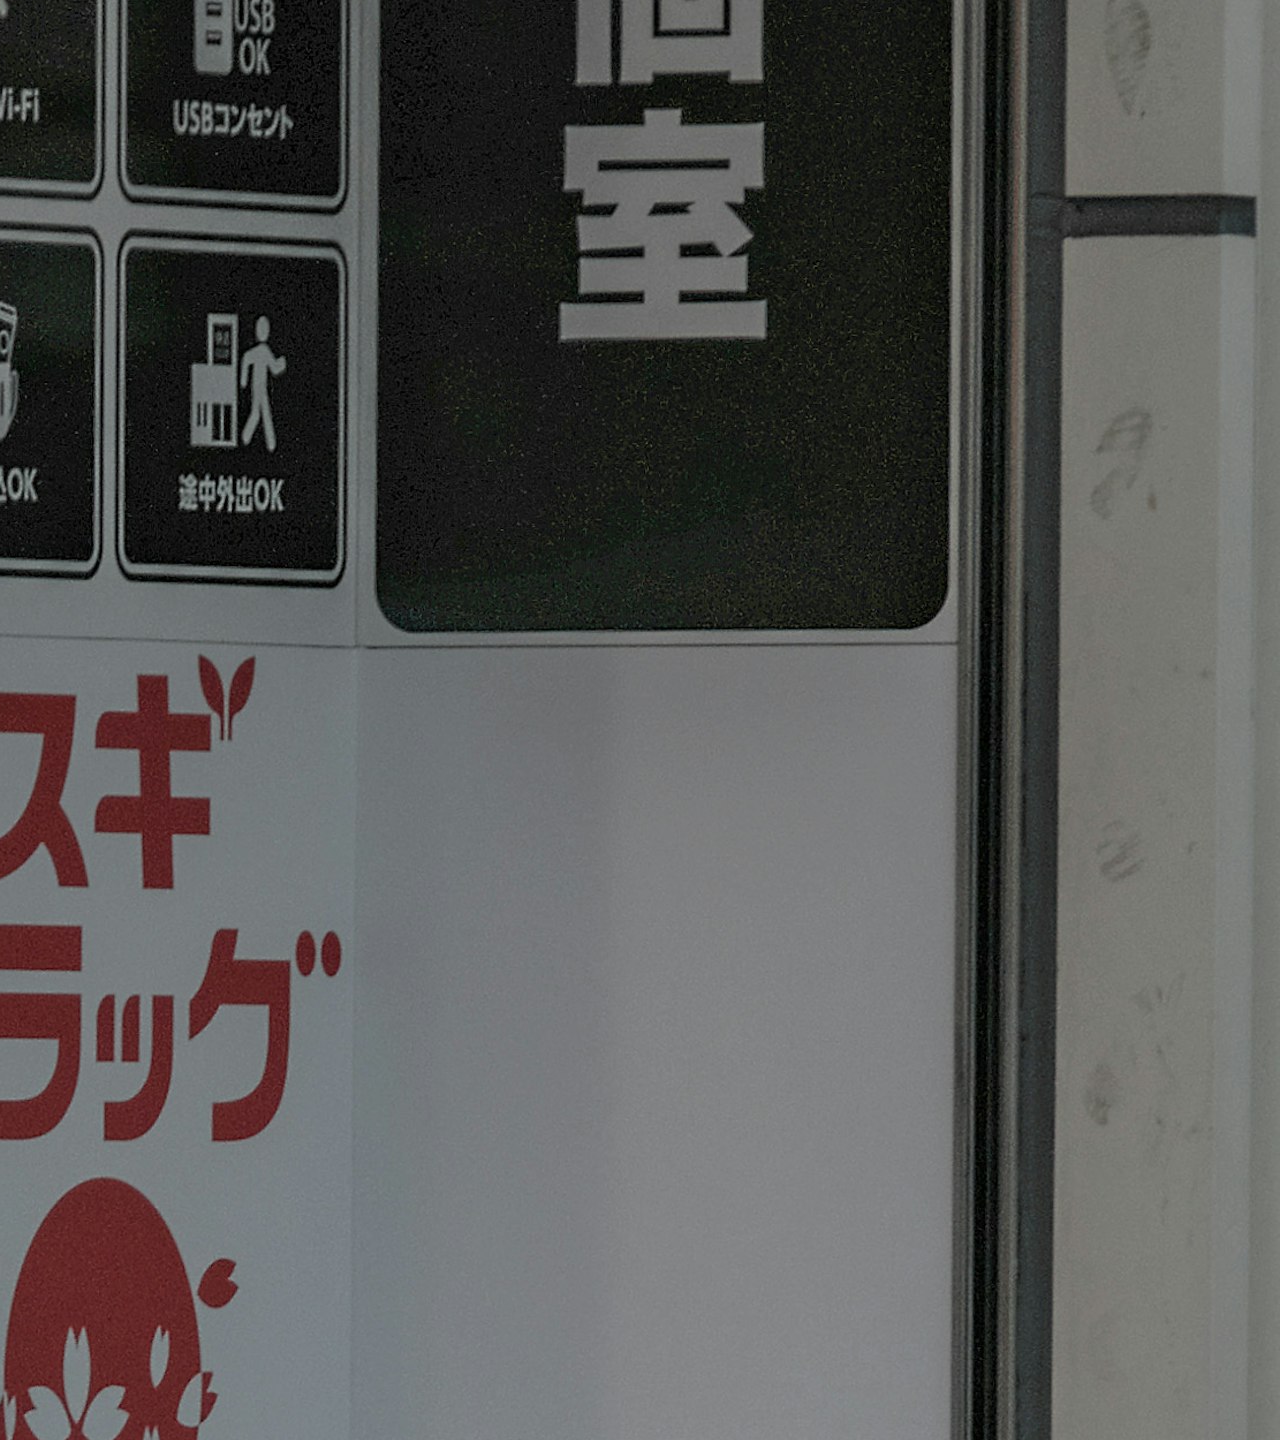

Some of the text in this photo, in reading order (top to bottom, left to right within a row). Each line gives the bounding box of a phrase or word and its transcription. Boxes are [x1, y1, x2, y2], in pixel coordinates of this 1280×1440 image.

[238, 38, 271, 78] OK
[172, 98, 295, 144] USBコンセント
[178, 474, 286, 516] 途中外出OK
